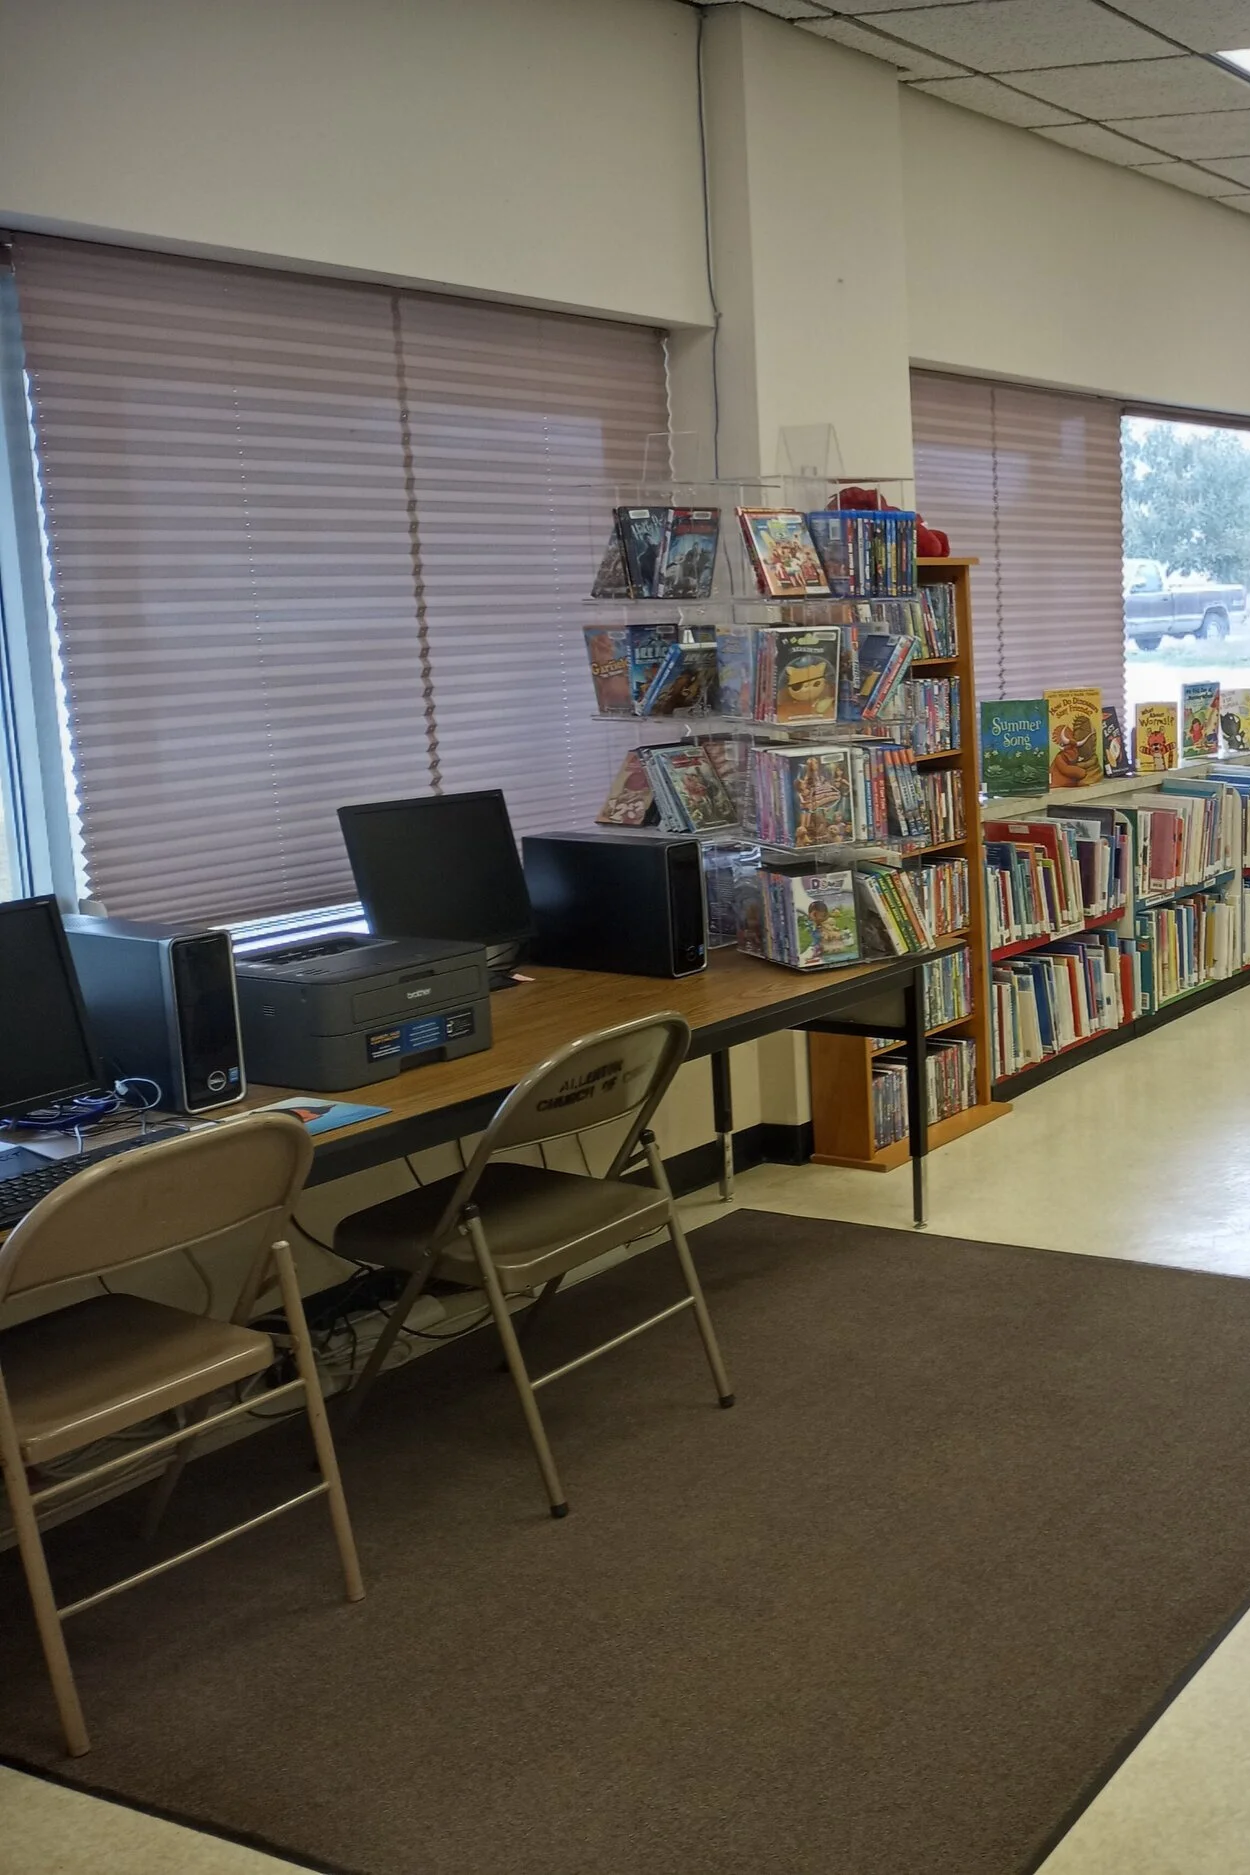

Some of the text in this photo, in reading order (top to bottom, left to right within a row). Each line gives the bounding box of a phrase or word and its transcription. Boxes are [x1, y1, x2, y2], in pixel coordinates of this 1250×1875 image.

[1063, 698, 1072, 707] Do
[992, 717, 1041, 736] Summer
[1003, 733, 1032, 750] Song
[406, 988, 431, 1000] brother
